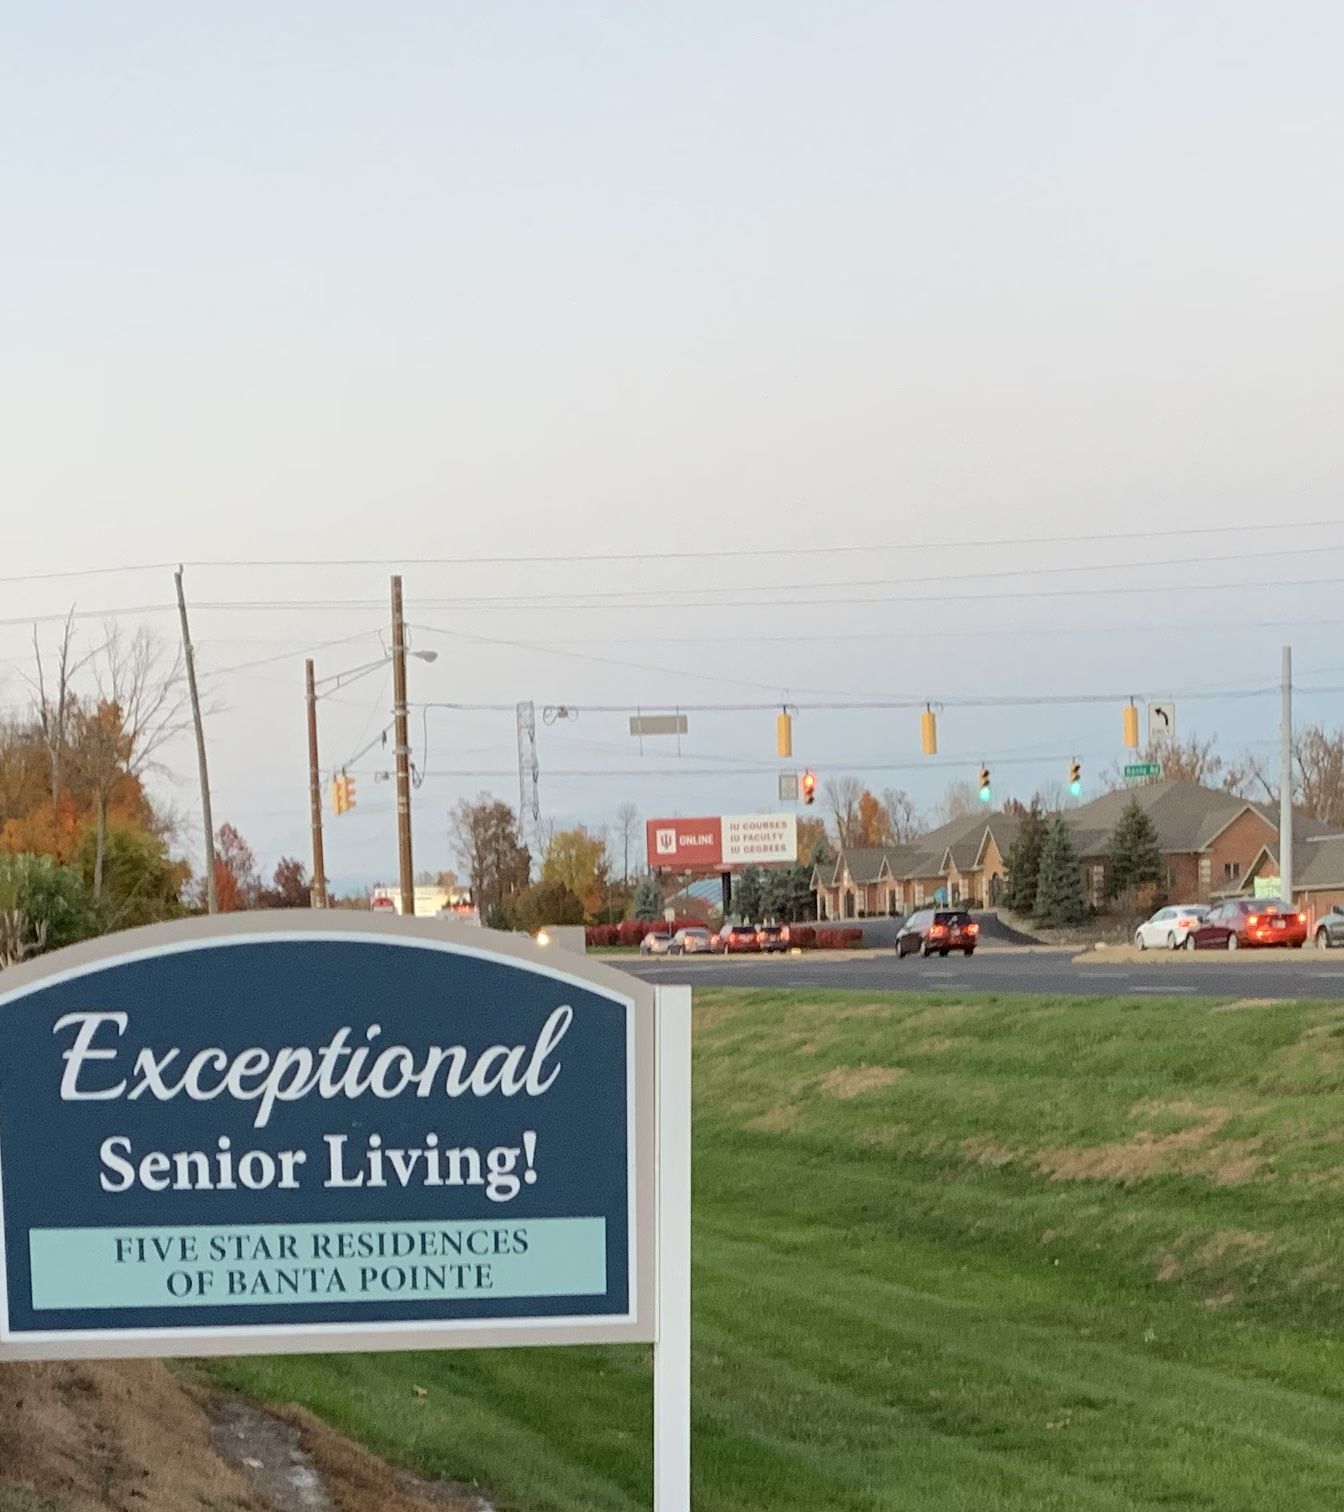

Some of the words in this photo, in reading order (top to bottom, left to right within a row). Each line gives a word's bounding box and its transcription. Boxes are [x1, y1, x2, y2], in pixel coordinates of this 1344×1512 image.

[730, 823, 740, 831] IU
[743, 821, 788, 830] COURSES
[731, 834, 741, 842] IU
[743, 833, 784, 842] FACULTY
[679, 834, 714, 846] ONLINE
[731, 846, 741, 854] IU
[743, 844, 787, 854] DEGREES
[52, 1004, 574, 1128] Exceptional
[99, 1135, 307, 1192] Senior
[323, 1130, 538, 1202] Living!
[114, 1235, 199, 1264] FIVE
[209, 1233, 300, 1262] STAR
[311, 1228, 530, 1260] RESIDENCES
[166, 1269, 214, 1297] OF
[226, 1266, 347, 1296] BANTA
[359, 1263, 494, 1293] POINTE
